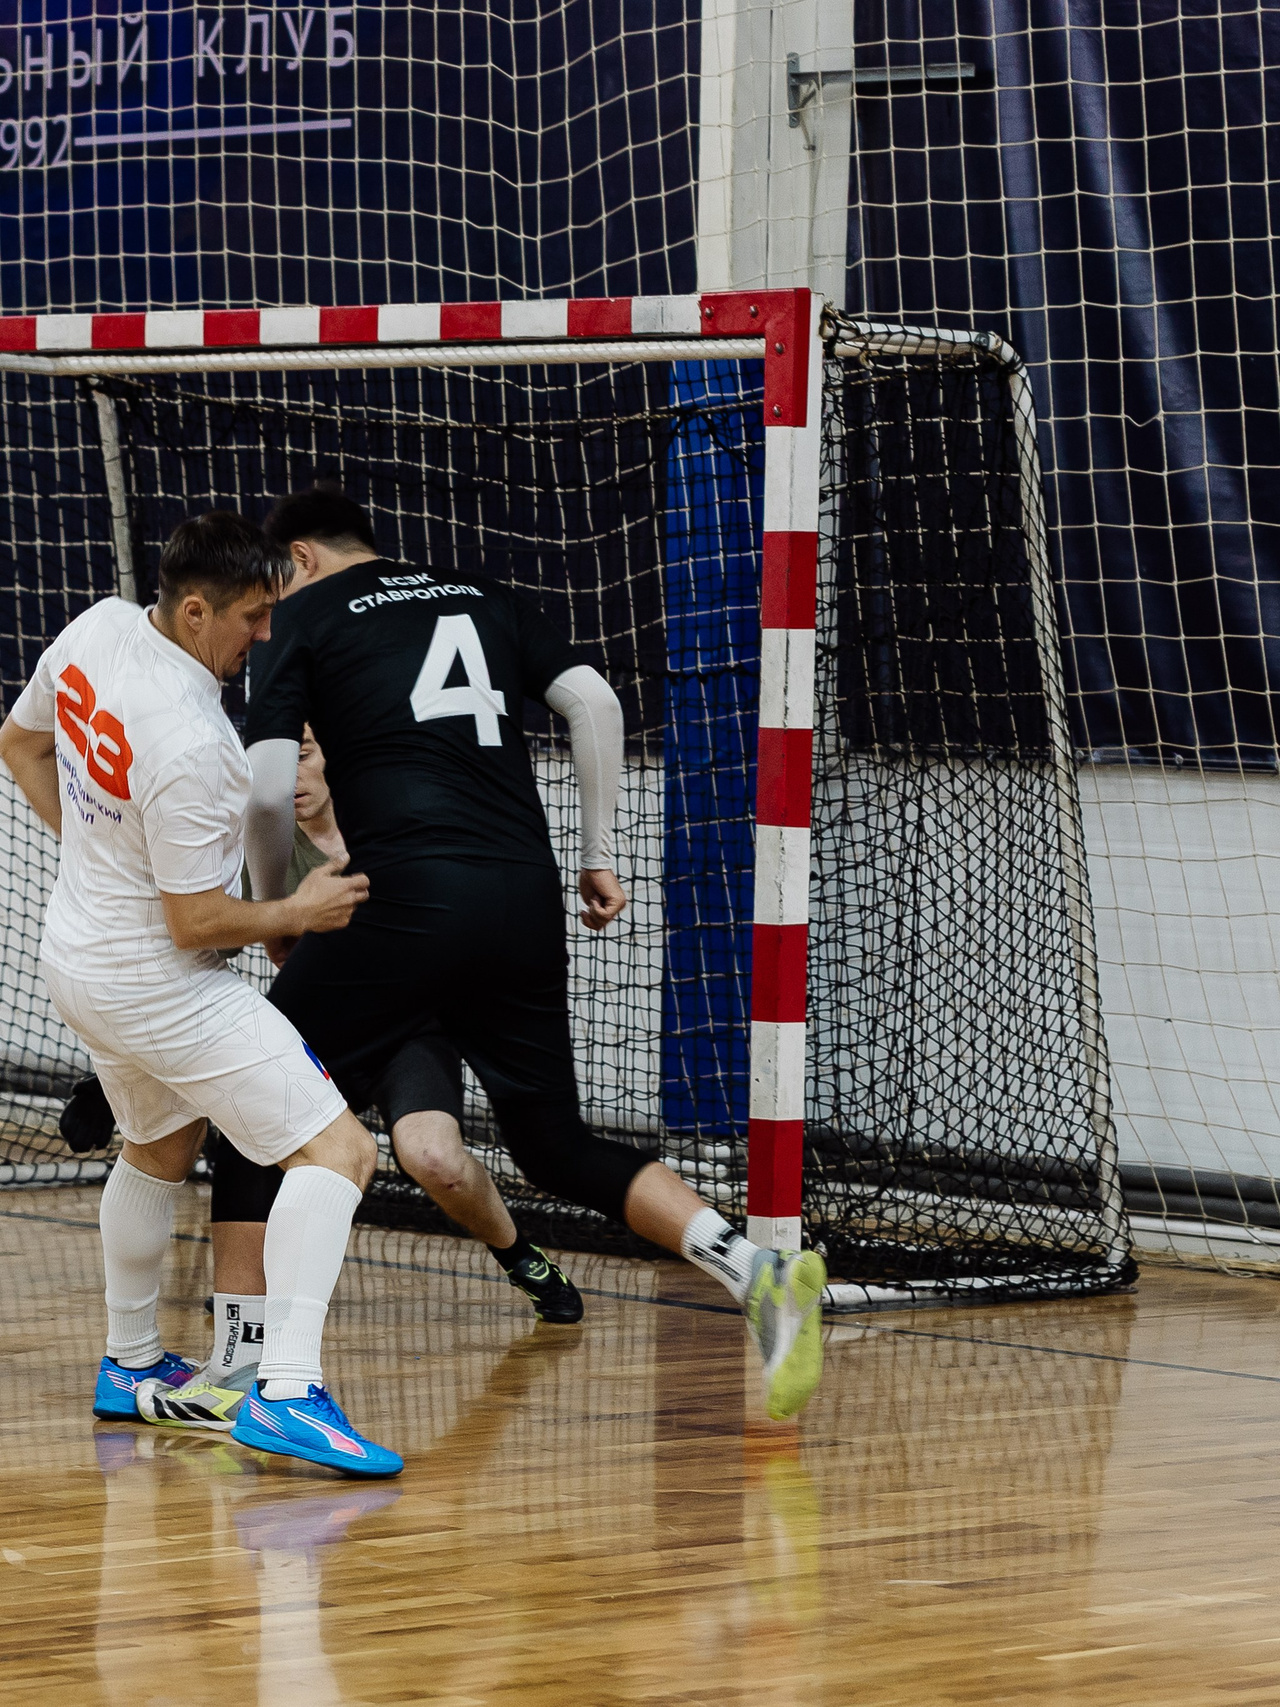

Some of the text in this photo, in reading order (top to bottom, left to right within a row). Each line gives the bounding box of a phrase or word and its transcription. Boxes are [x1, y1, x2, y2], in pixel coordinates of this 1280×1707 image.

[195, 8, 355, 78] КЛУБ
[410, 613, 508, 746] 4
[56, 664, 133, 800] 23
[222, 1320, 240, 1368] TAPEDESIGN
